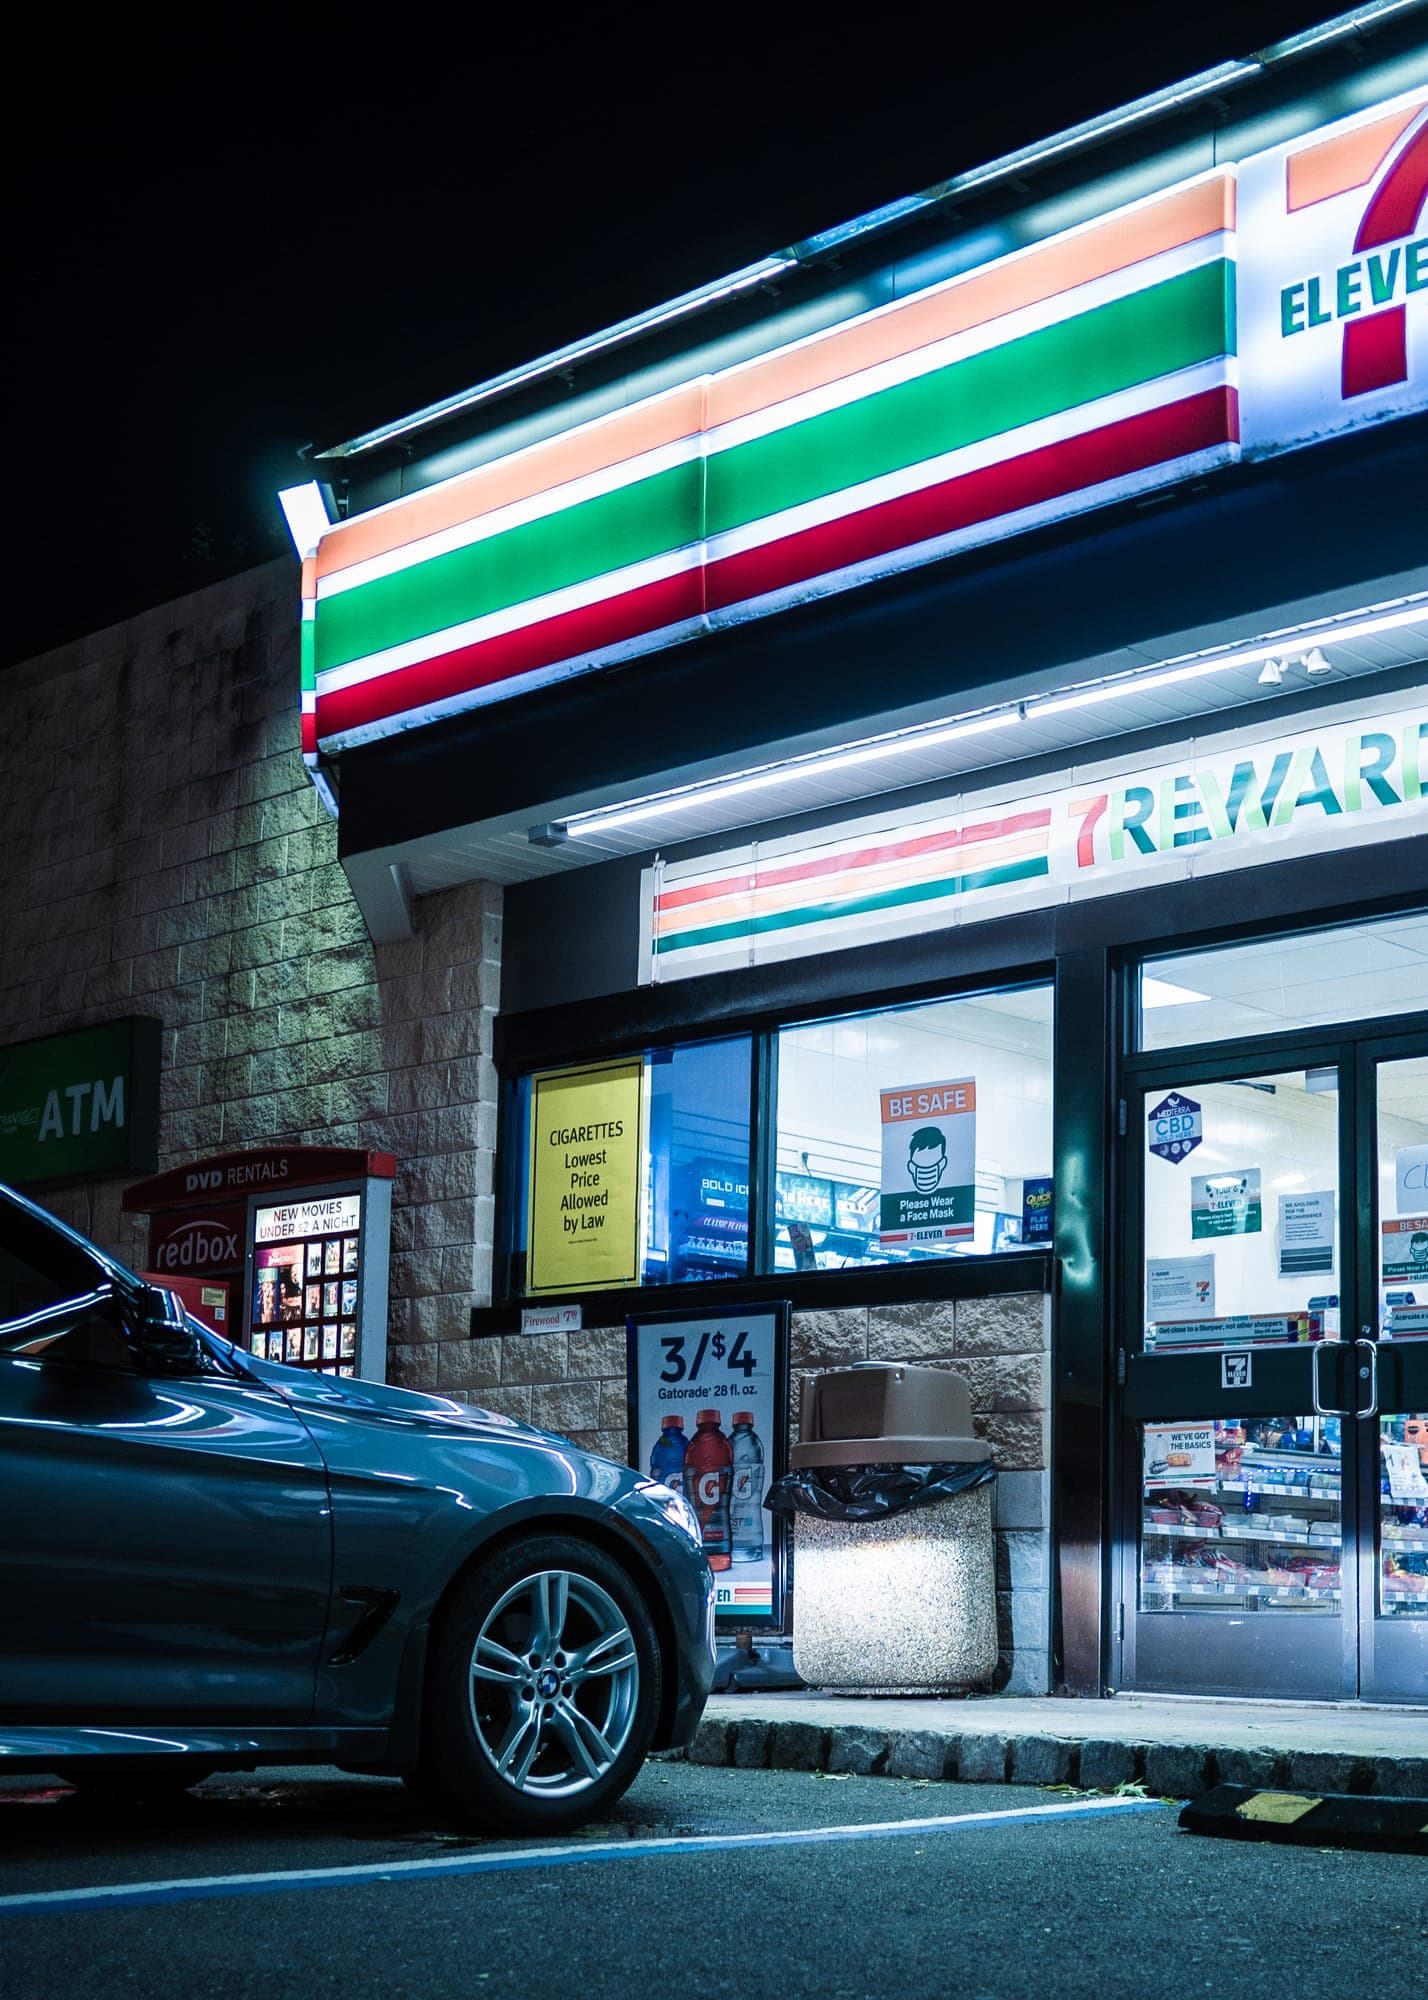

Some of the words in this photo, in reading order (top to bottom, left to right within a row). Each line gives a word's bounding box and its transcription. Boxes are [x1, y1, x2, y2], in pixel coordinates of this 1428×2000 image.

[38, 1075, 125, 1142] ATM
[889, 1096, 913, 1118] BE
[917, 1089, 966, 1114] SAFE
[1157, 1105, 1191, 1118] MEDTERRA
[550, 1121, 624, 1146] CIGARETTES
[1156, 1115, 1194, 1136] CBD
[1156, 1134, 1174, 1142] SOLD
[565, 1149, 607, 1169] Lowest
[186, 1170, 223, 1192] DVD
[227, 1159, 288, 1185] RENTALS
[570, 1171, 600, 1189] Price
[702, 1178, 733, 1193] BOLD
[560, 1190, 609, 1211] Allowed
[900, 1198, 929, 1211] Please
[930, 1196, 954, 1208] Wear
[273, 1207, 299, 1223] NEW
[302, 1201, 342, 1218] MOVIES
[900, 1214, 906, 1223] a
[908, 1211, 928, 1222] Face
[929, 1208, 954, 1219] Mask
[1030, 1215, 1049, 1224] PLAY
[260, 1223, 295, 1239] UNDER
[298, 1221, 309, 1233] $2
[312, 1220, 320, 1232] A
[323, 1215, 356, 1230] NIGHT
[563, 1215, 578, 1235] by
[581, 1213, 605, 1230] Law
[1399, 1221, 1413, 1231] BE
[156, 1232, 239, 1269] redbox
[524, 1312, 560, 1328] Firewood
[1158, 1326, 1170, 1335] Get
[1171, 1326, 1186, 1334] close
[1225, 1322, 1236, 1330] not
[1236, 1321, 1253, 1329] other
[1254, 1319, 1284, 1329] shoppers.
[659, 1330, 757, 1383] 3/$4
[1228, 1357, 1246, 1384] 7
[714, 1385, 728, 1398] 28
[730, 1383, 741, 1397] fl.
[742, 1385, 758, 1398] oz.
[1170, 1442, 1184, 1450] THE
[1184, 1441, 1212, 1450] BASICS
[1171, 1433, 1194, 1441] WE'VE
[1194, 1431, 1210, 1440] GOT
[698, 1471, 720, 1505] G
[732, 1467, 752, 1500] G
